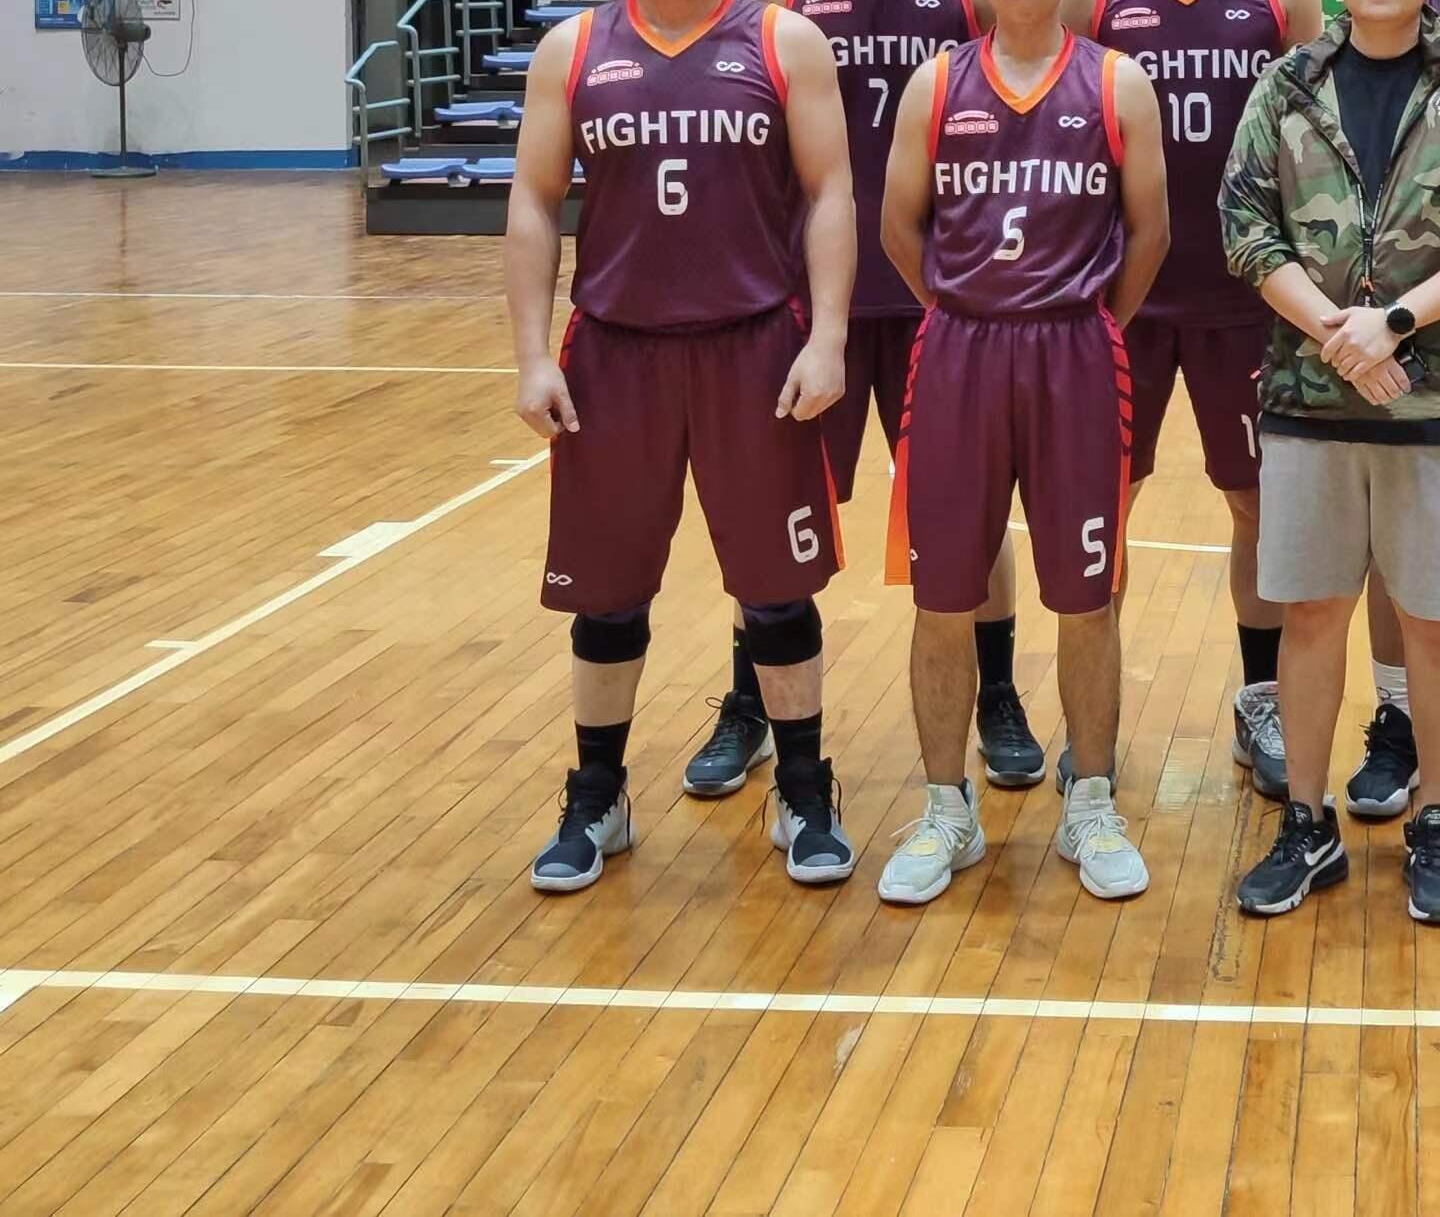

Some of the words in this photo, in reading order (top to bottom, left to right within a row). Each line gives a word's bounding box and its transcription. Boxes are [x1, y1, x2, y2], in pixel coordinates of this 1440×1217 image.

[868, 77, 890, 128] 7
[1168, 92, 1212, 143] 10
[580, 109, 771, 155] FIGHTING
[656, 158, 689, 216] 6
[934, 158, 1108, 196] FIGHTING
[992, 205, 1028, 261] 5
[1240, 413, 1261, 459] 1
[786, 504, 820, 564] 6
[1081, 515, 1107, 578] 5
